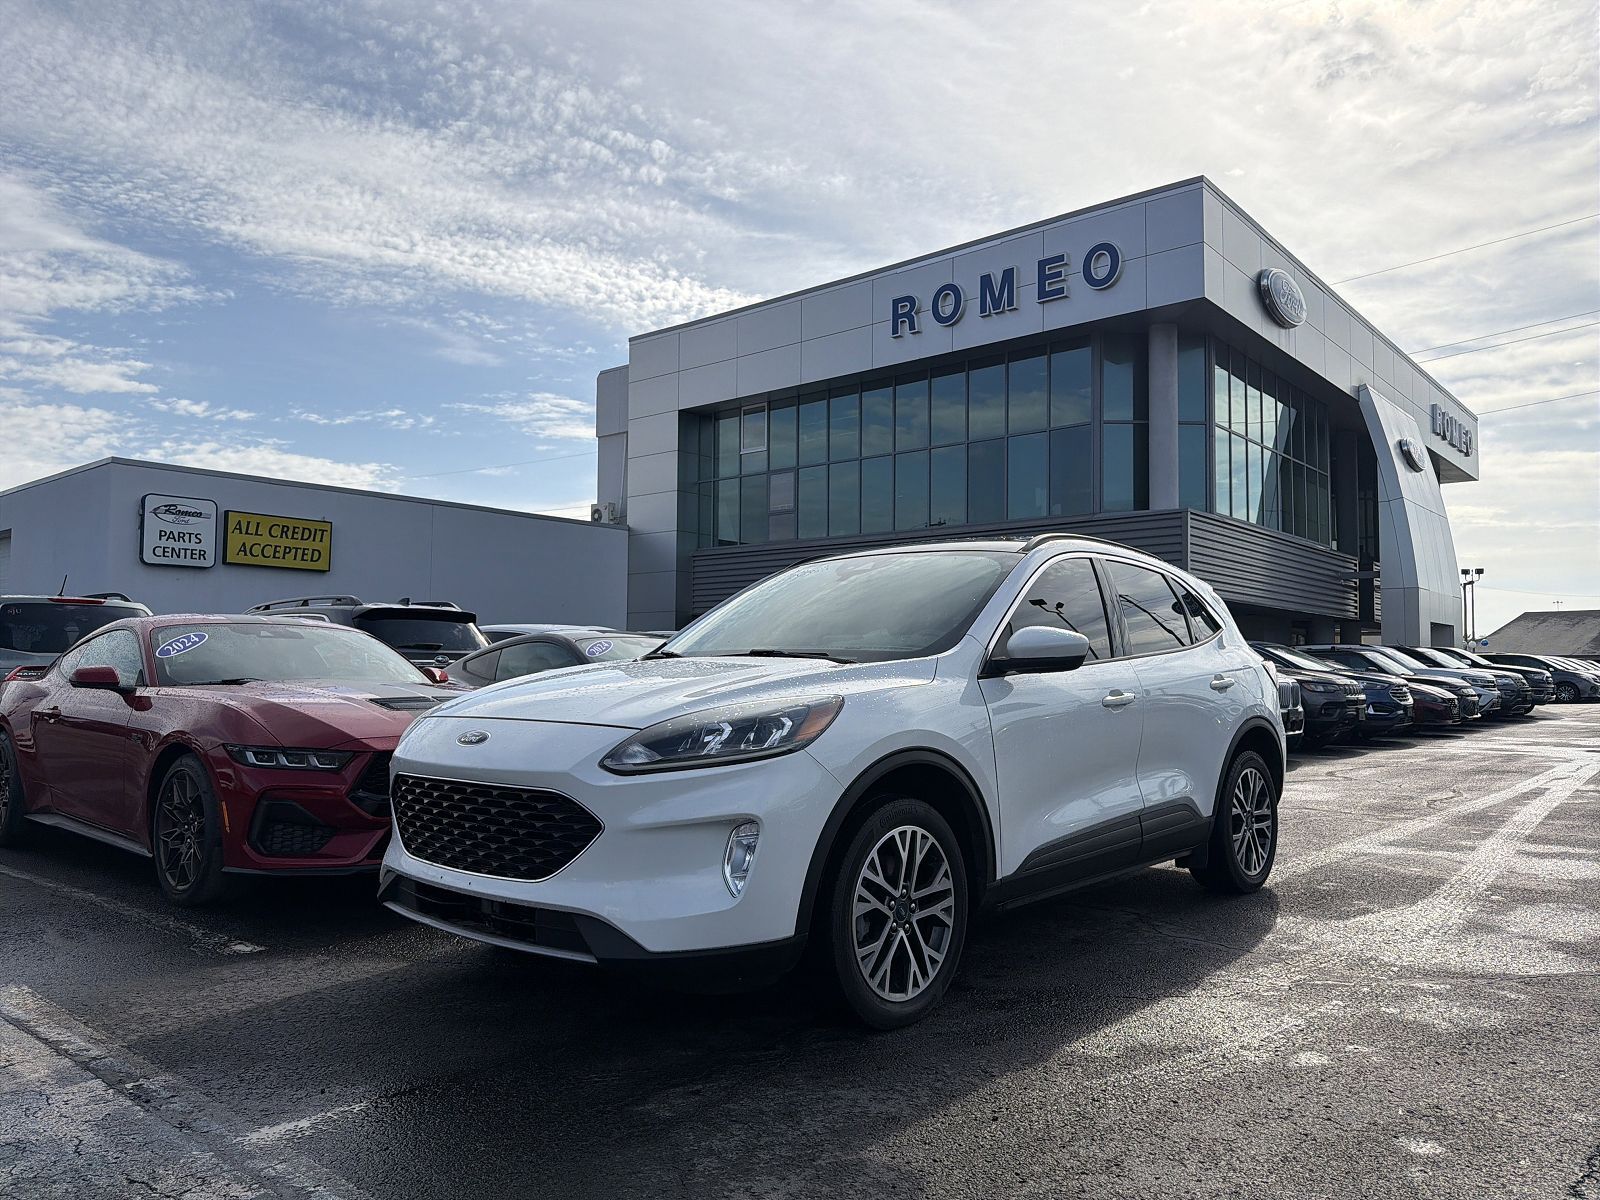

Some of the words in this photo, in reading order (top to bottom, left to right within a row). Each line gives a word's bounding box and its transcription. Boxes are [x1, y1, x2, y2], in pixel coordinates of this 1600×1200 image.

[890, 240, 1123, 338] ROMEO
[1432, 403, 1473, 457] ROMEO
[163, 504, 203, 518] Romeo
[158, 529, 203, 545] PARTS
[231, 519, 264, 537] ALL
[268, 523, 328, 542] CREDIT
[152, 545, 207, 561] CENTER
[236, 541, 322, 563] ACCEPTED
[164, 634, 200, 655] 2024
[589, 641, 610, 655] 2024
